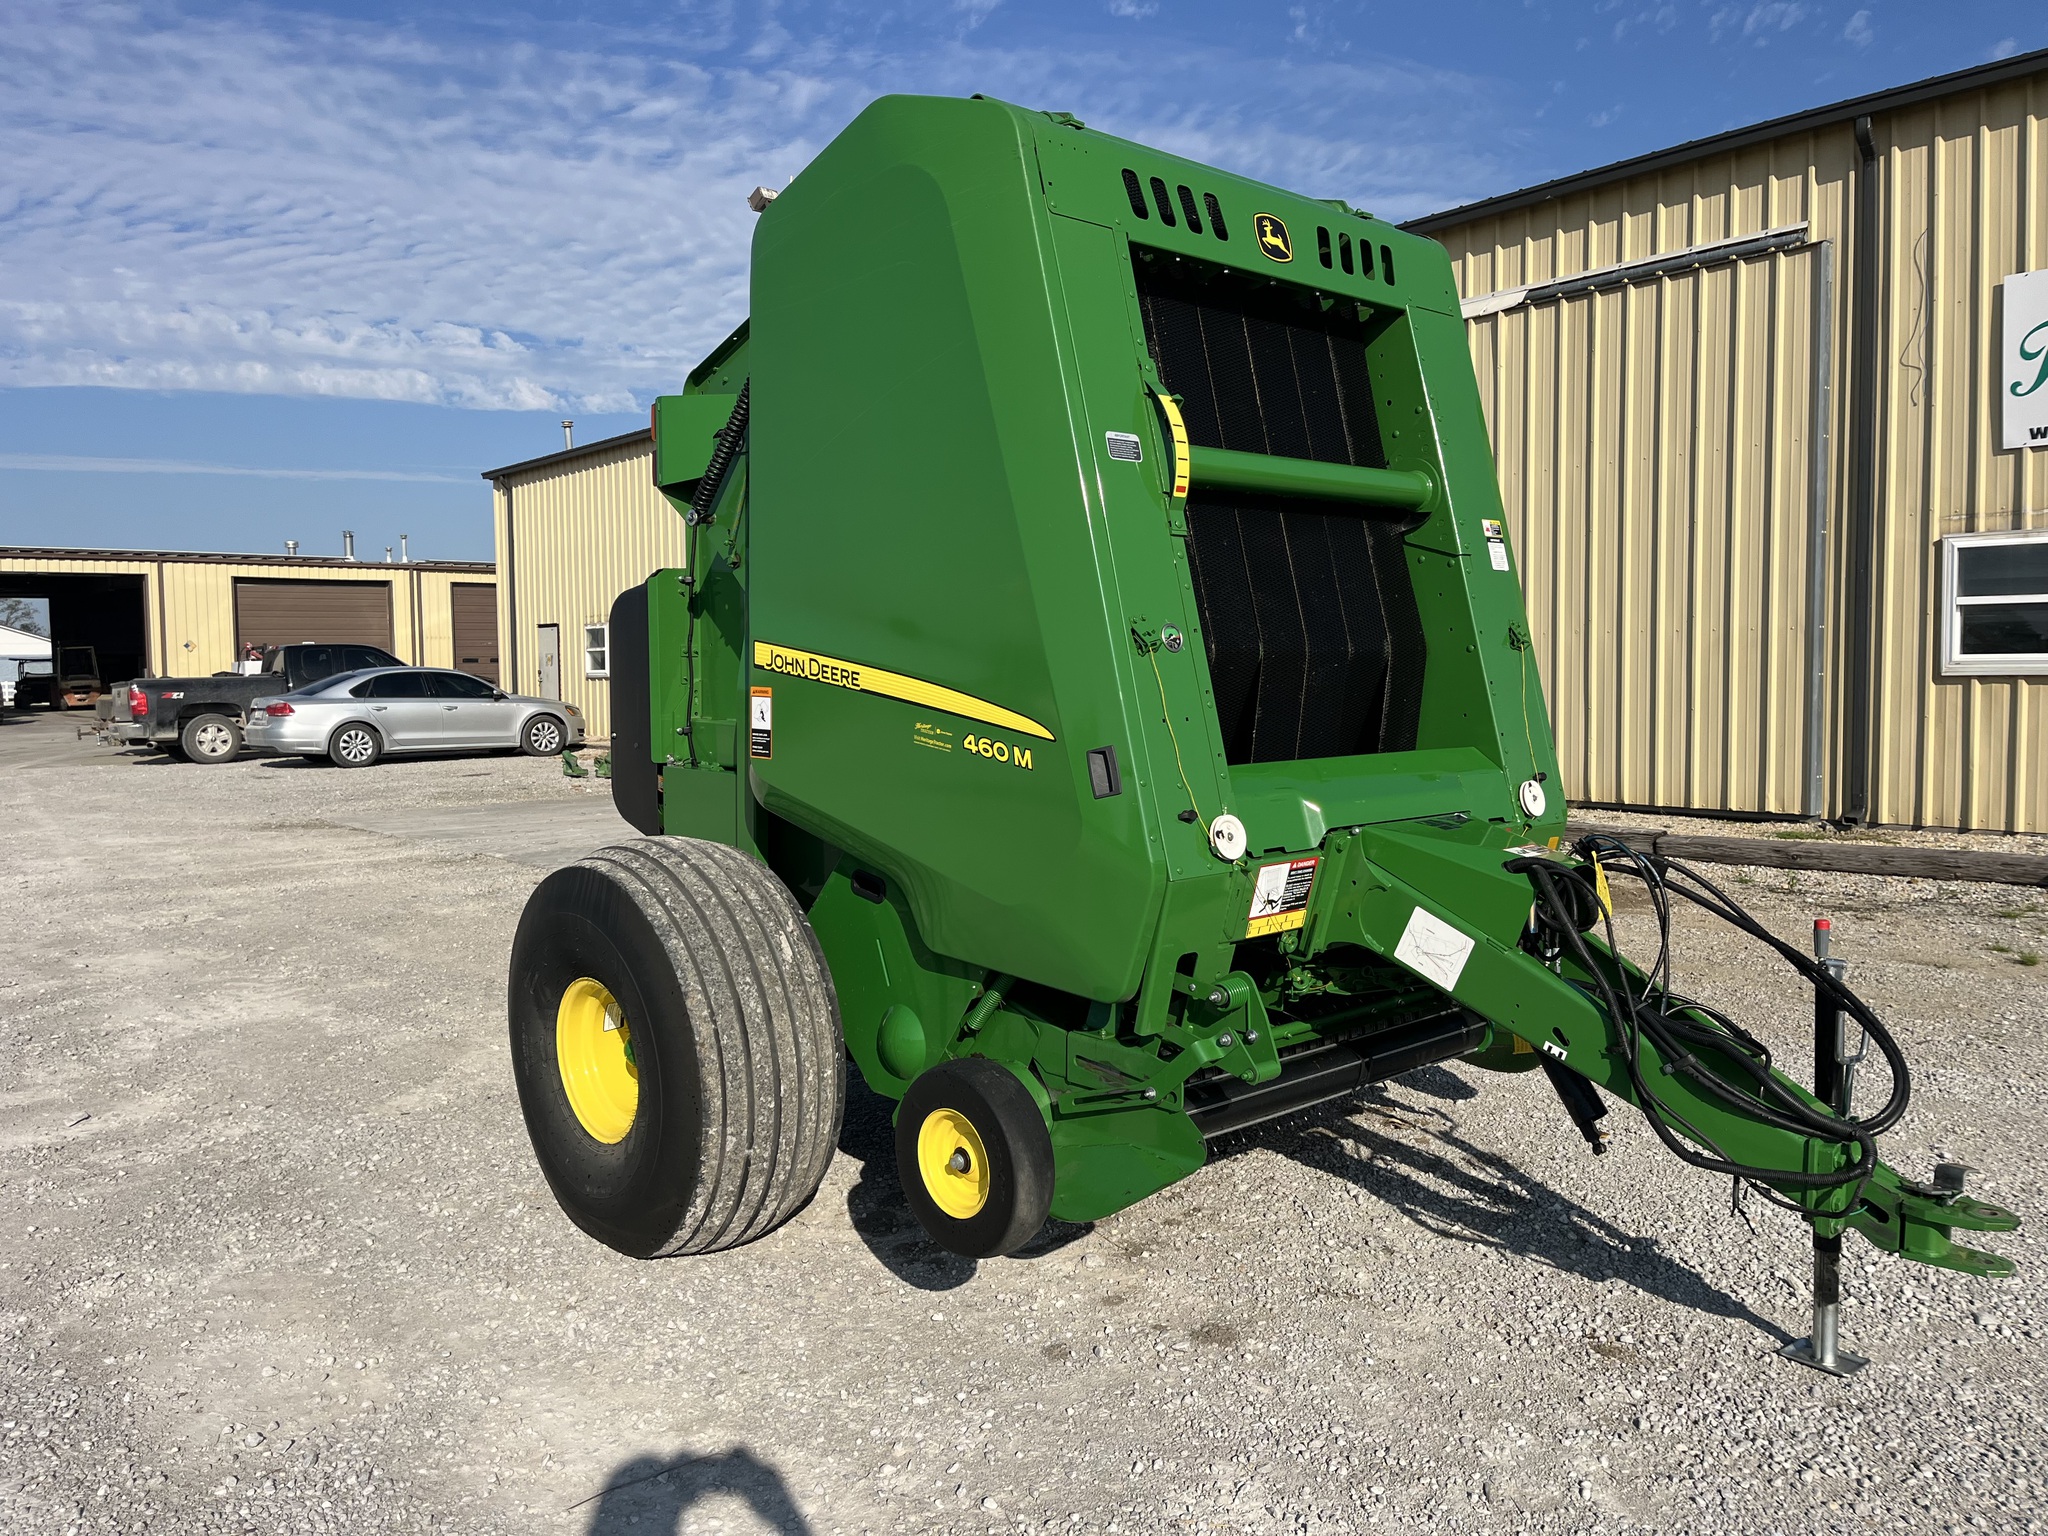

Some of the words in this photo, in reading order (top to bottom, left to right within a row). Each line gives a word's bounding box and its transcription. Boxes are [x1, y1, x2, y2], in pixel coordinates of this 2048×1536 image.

[766, 649, 805, 675] JOHN
[809, 658, 861, 687] DEERE
[962, 733, 1010, 763] 460
[1012, 745, 1034, 771] M
